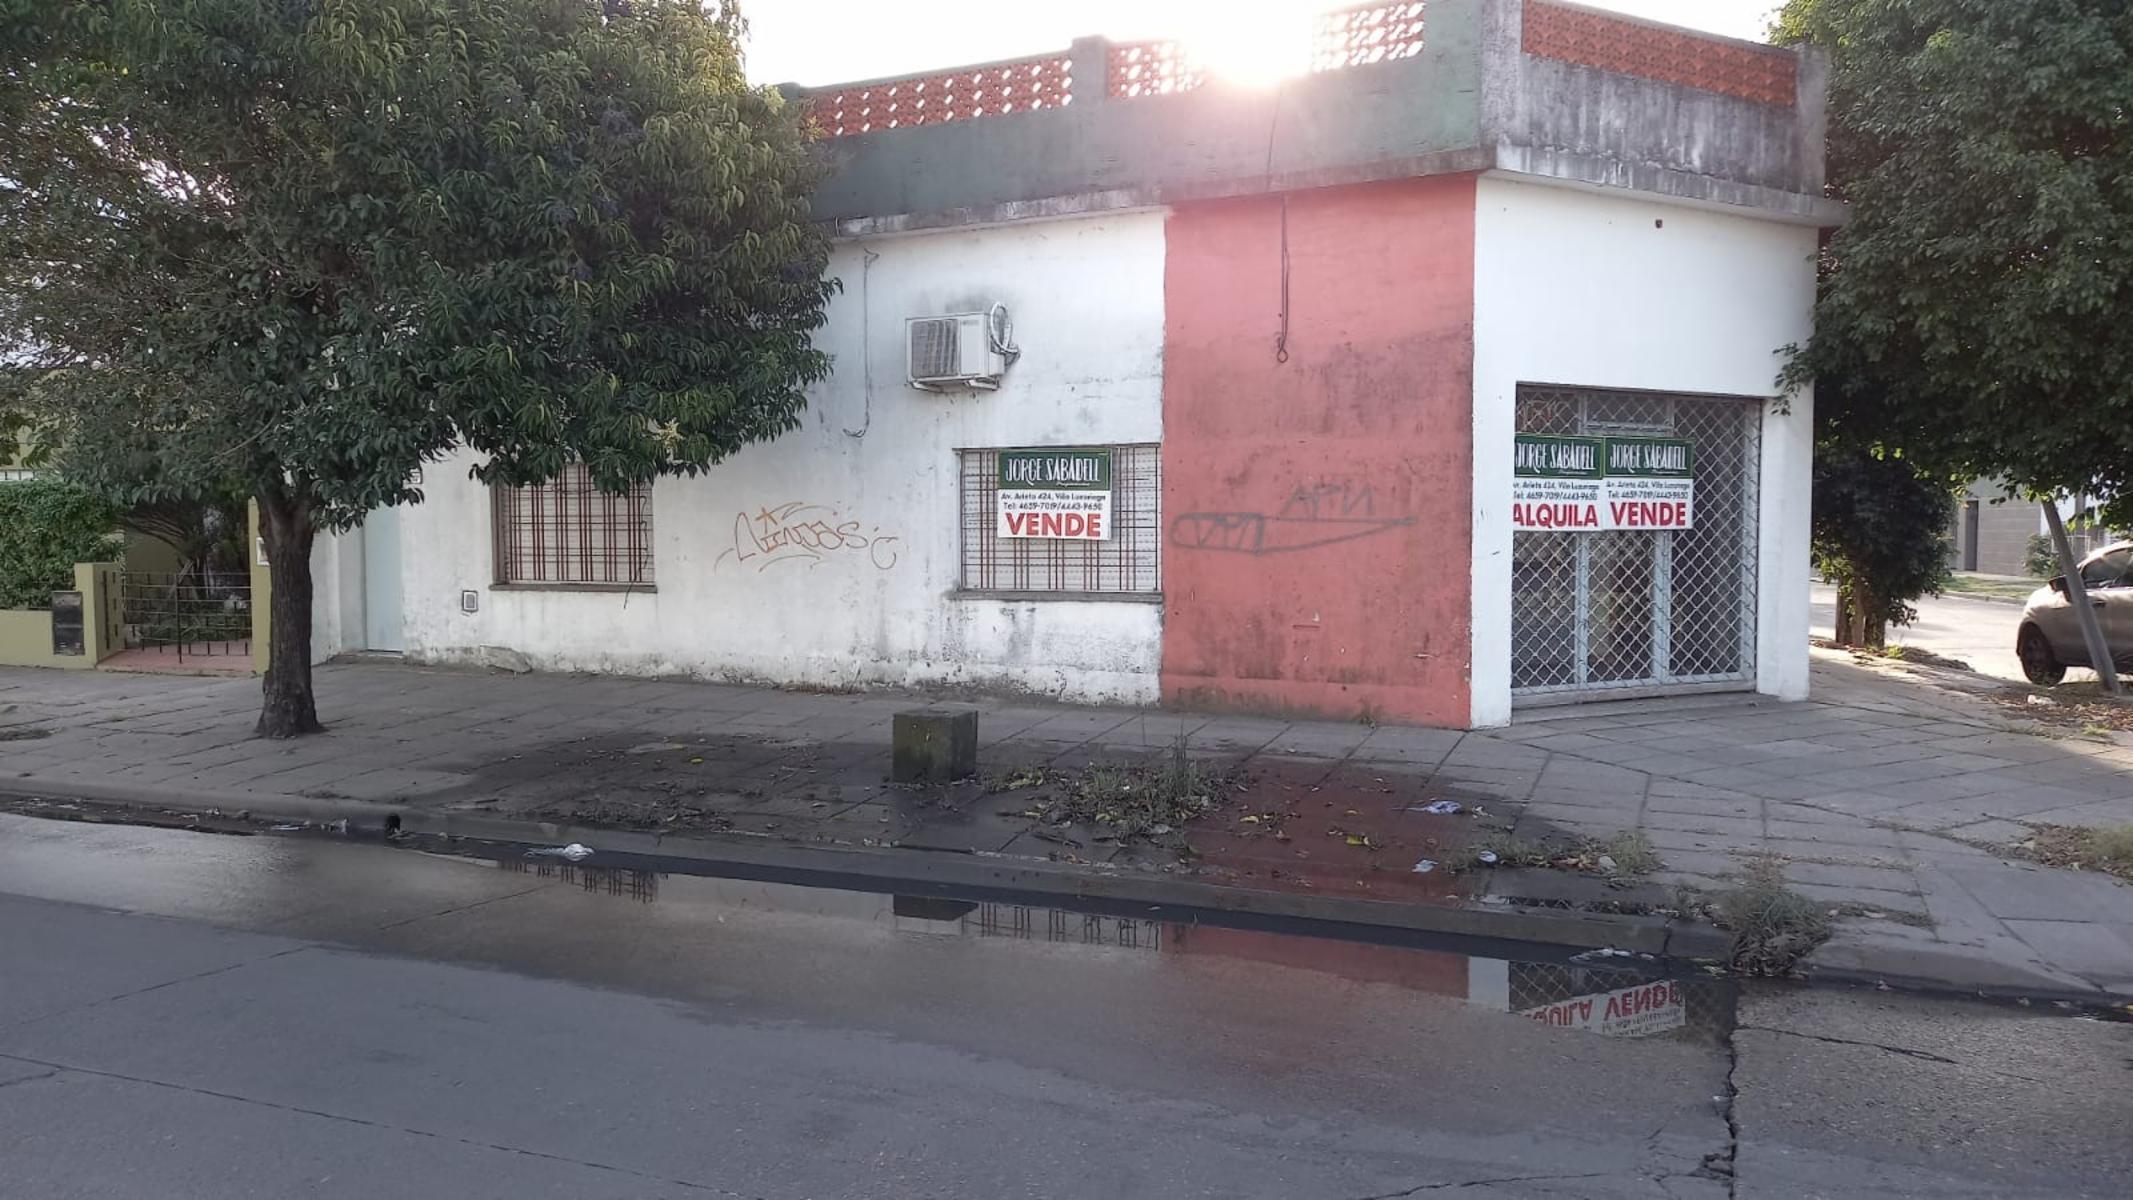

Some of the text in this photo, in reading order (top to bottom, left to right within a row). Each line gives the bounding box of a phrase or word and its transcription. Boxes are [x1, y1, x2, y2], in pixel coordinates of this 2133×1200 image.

[1005, 453, 1101, 487] JORGE SABADELL
[1516, 440, 1597, 474] JORGE SABADELL
[1609, 440, 1688, 474] JORGE SABADELL
[1005, 512, 1101, 537] VENDE
[1514, 503, 1599, 529] ALQUILA
[1610, 501, 1686, 526] VENDE
